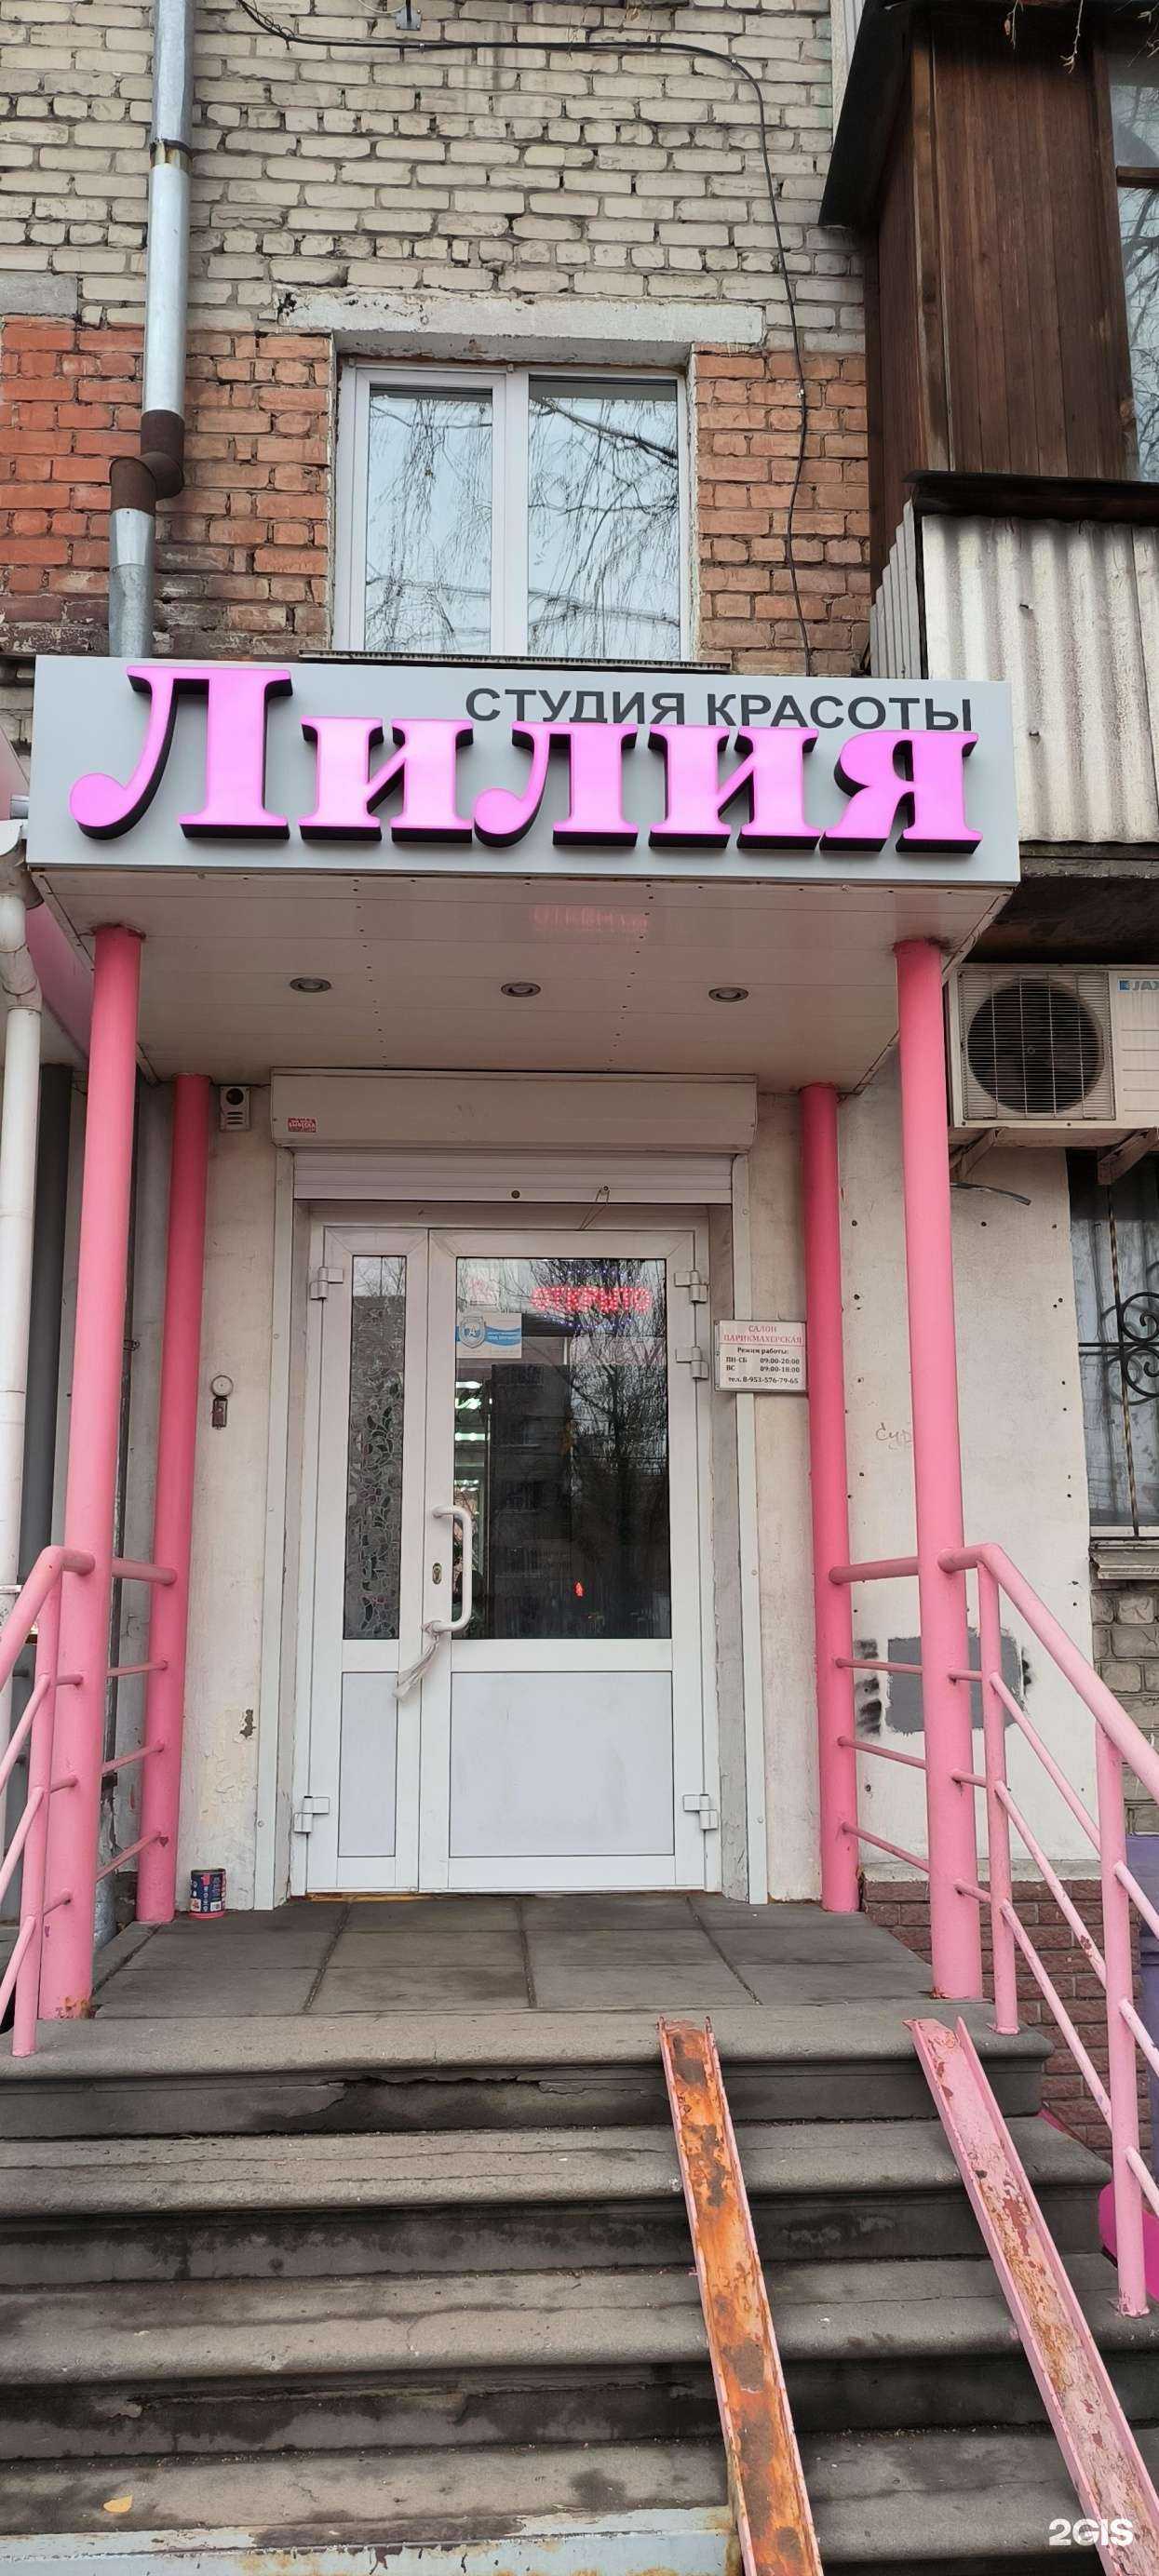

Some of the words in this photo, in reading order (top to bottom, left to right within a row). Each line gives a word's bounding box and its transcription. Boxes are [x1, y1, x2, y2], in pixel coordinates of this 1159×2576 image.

[465, 688, 685, 725] СТУДИЯ
[707, 693, 973, 731] КРАСОТЫ
[70, 665, 983, 853] Лилия
[531, 1285, 652, 1314] ОТКРЫТО
[723, 1335, 802, 1344] ПАРИКМАХЕРСКАЯ
